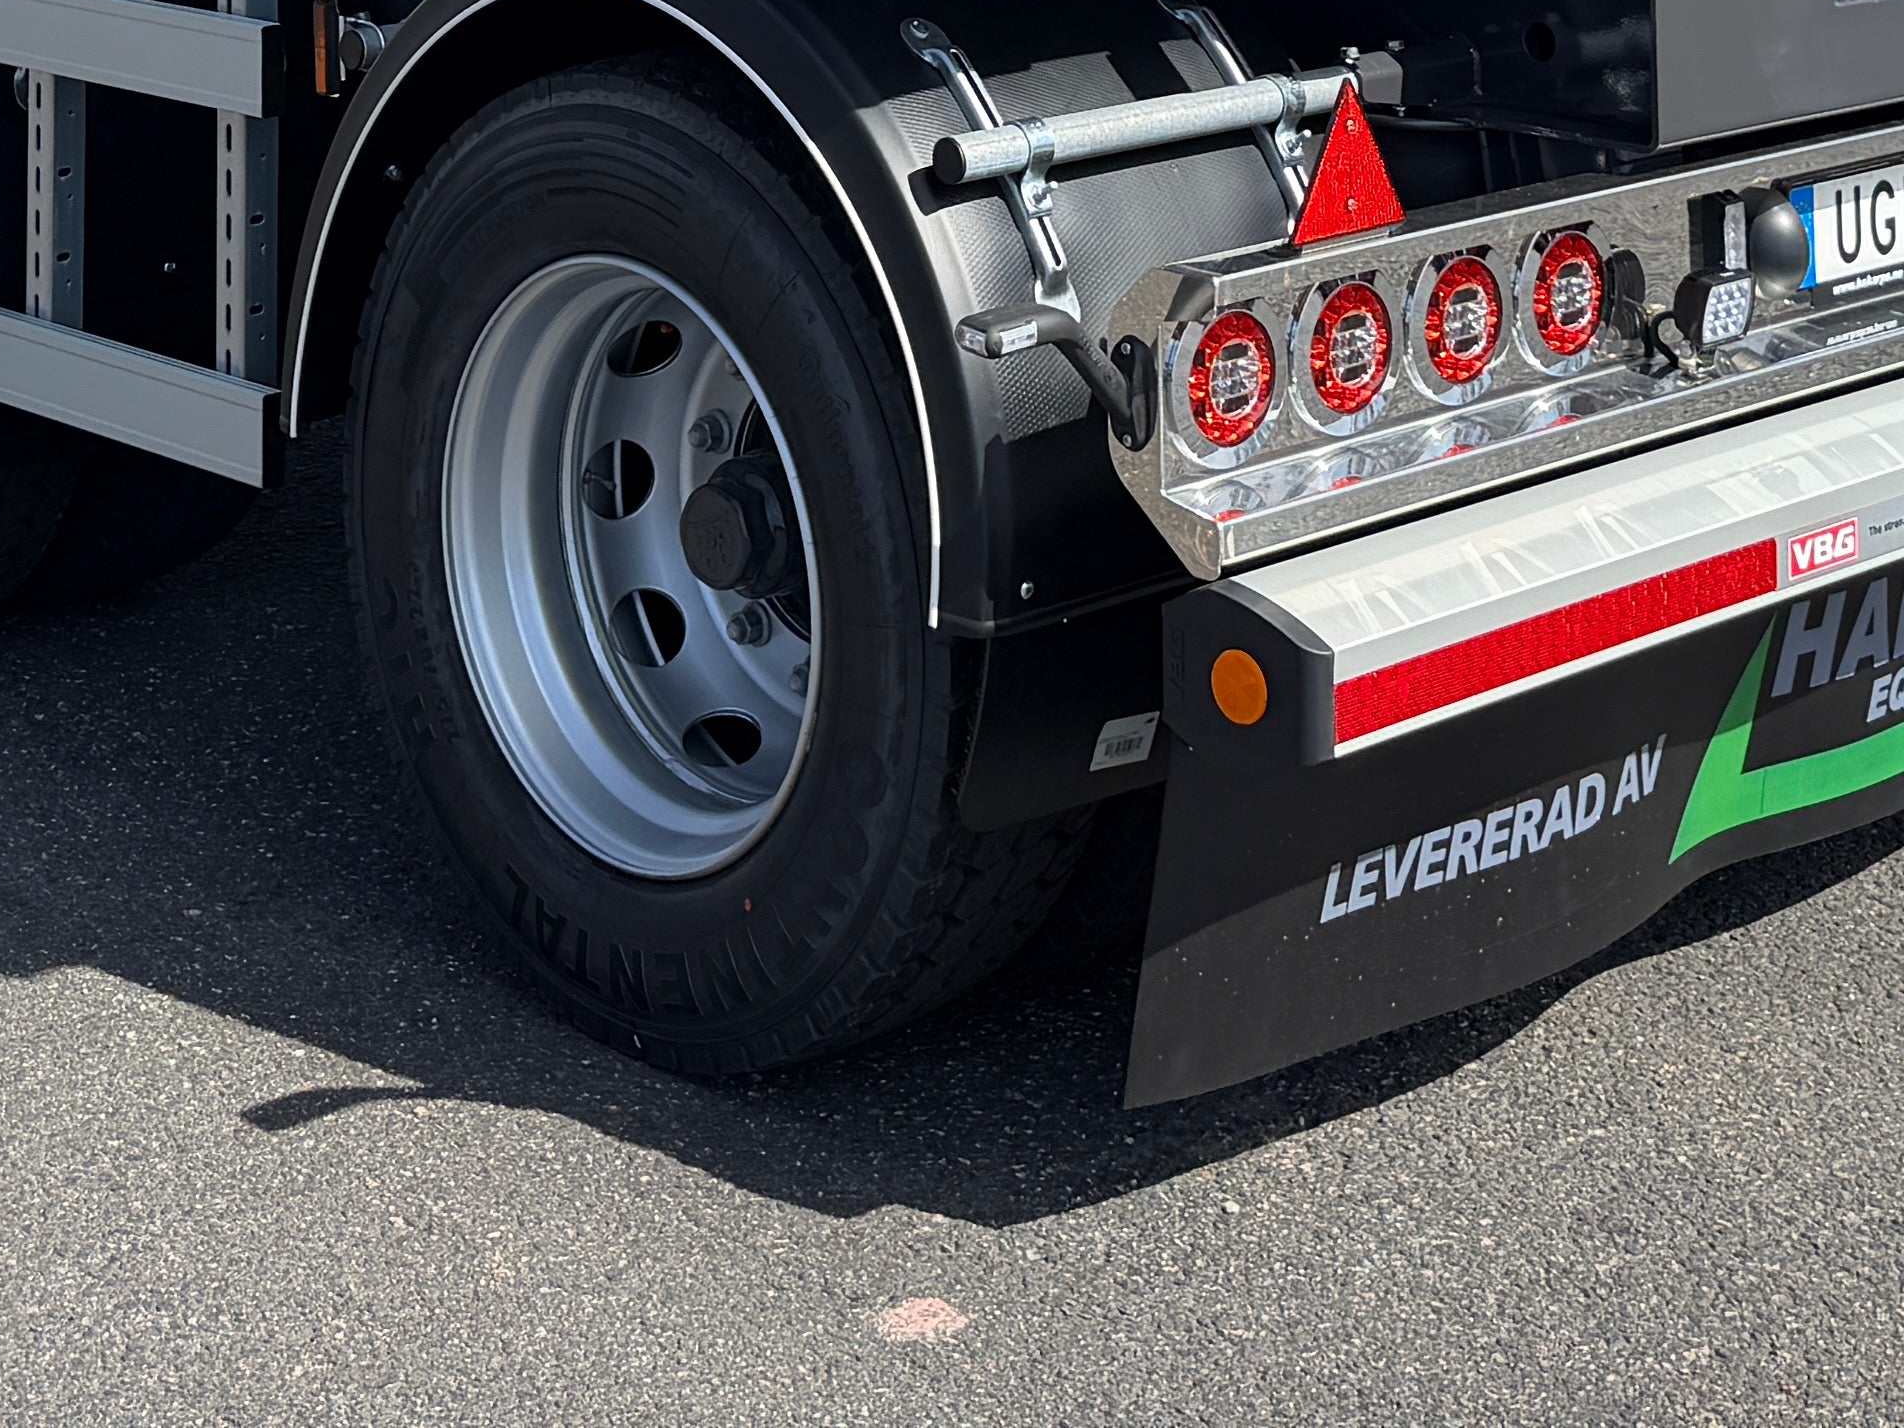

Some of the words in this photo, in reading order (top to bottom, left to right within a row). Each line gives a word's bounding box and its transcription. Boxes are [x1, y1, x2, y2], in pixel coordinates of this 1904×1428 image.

[1792, 525, 1855, 570] VBG
[1320, 772, 1605, 923] LEVERERAD
[1612, 733, 1668, 816] AV
